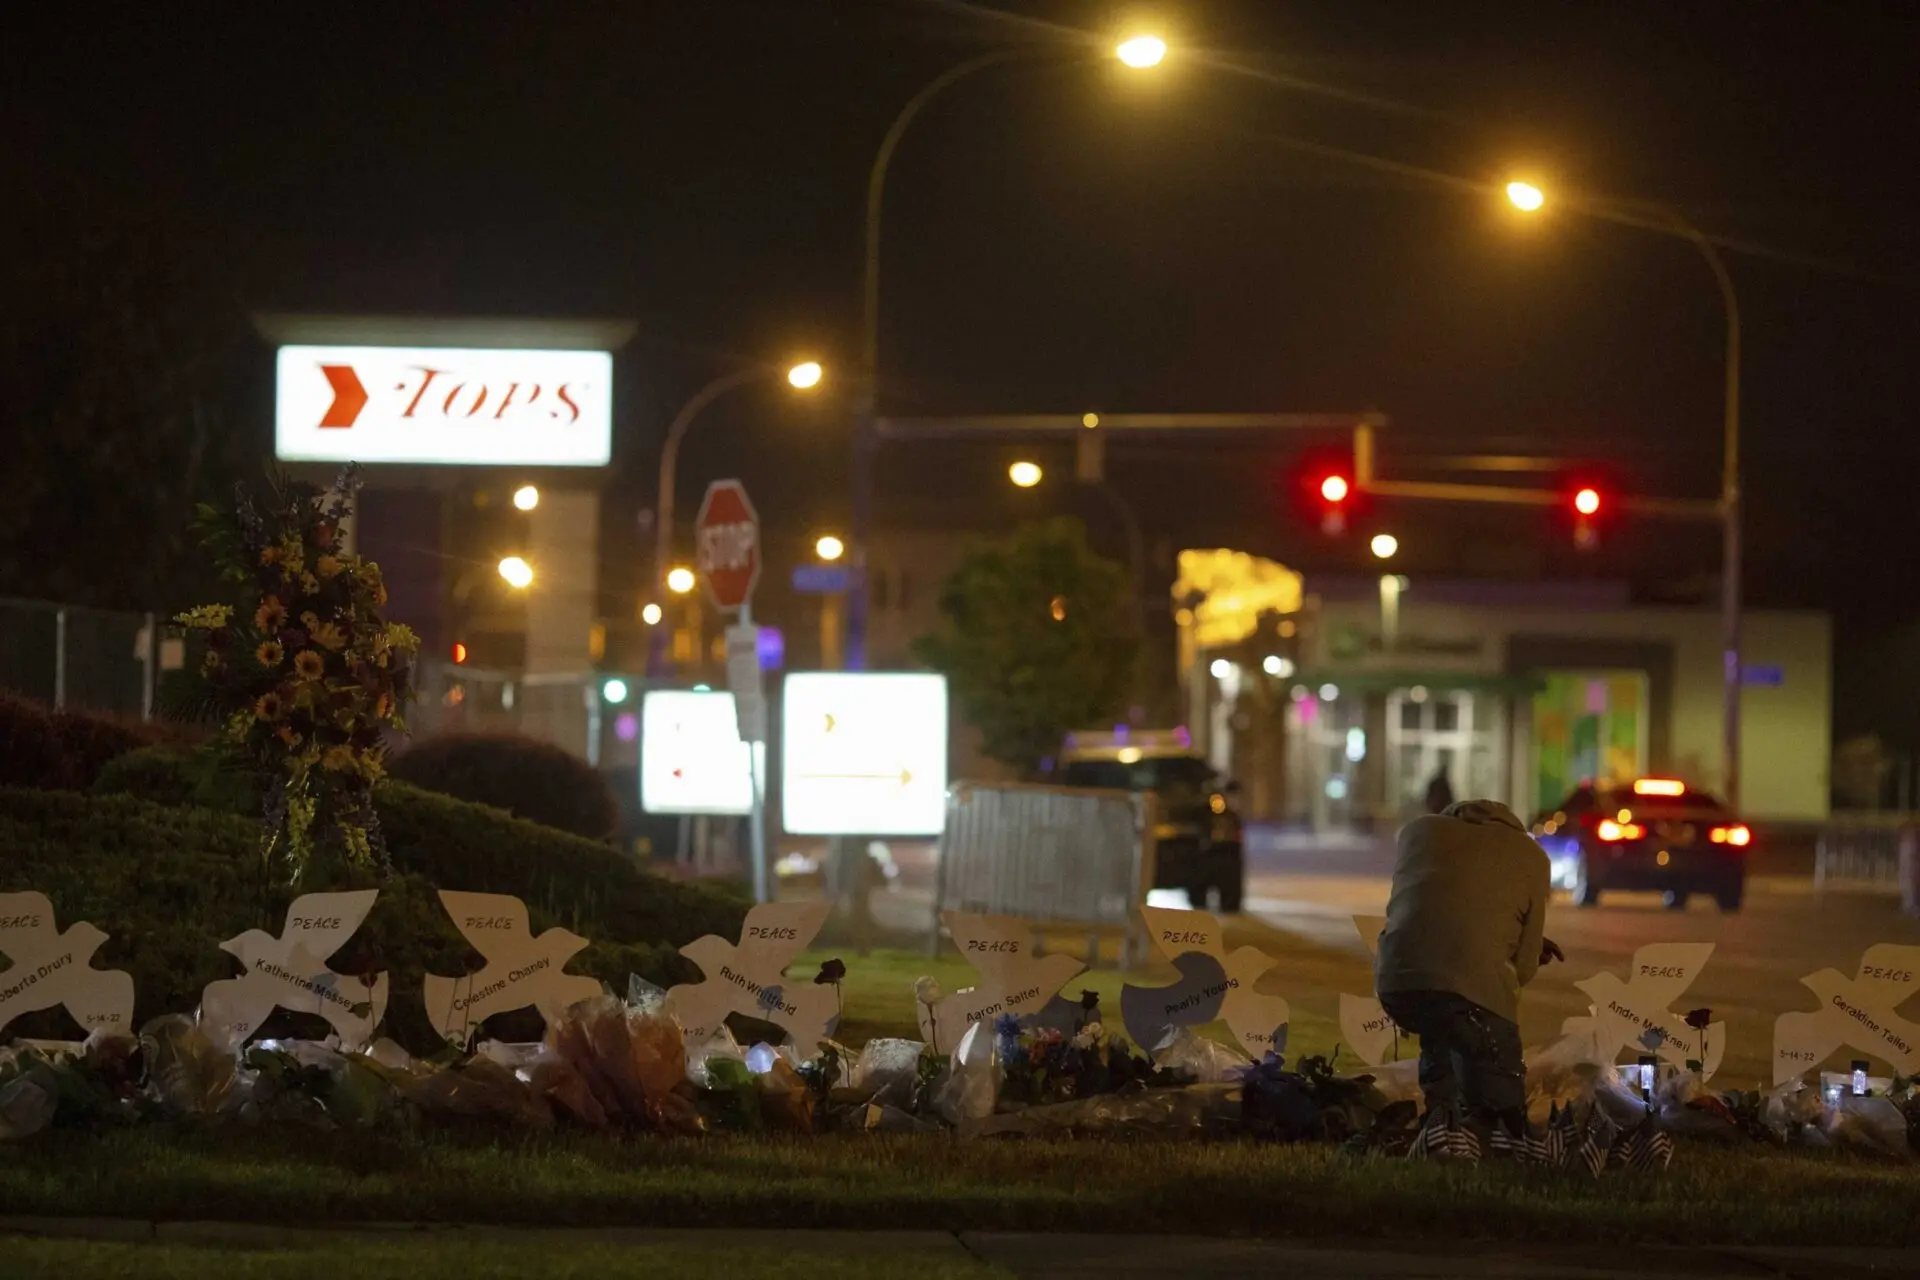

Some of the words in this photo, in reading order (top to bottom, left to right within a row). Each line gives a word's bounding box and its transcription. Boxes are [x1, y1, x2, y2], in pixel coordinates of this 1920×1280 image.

[701, 520, 757, 572] STOP
[0, 914, 41, 928] EACE
[292, 917, 342, 930] PEACE
[465, 917, 514, 930] PEACE
[749, 926, 798, 940] PEACE
[1163, 930, 1209, 945] PEACE
[967, 940, 1020, 953] PEACE
[37, 952, 73, 979] Drury
[255, 958, 313, 990] Katherine
[1640, 965, 1685, 979] PEACE
[1863, 965, 1914, 983] PEACE
[453, 979, 506, 1011] Celestine
[508, 956, 551, 983] Chaney
[719, 965, 747, 988] Ruth
[747, 981, 798, 1017] Whitfield
[966, 1002, 1002, 1025] Aaron
[1005, 986, 1042, 1007] Salter
[1165, 992, 1201, 1016] Pearly
[1202, 977, 1240, 1000] Young
[1608, 1000, 1641, 1024] Andre
[1832, 994, 1880, 1033] Geraldine
[1882, 1027, 1914, 1056] Talley
[1780, 1049, 1815, 1061] 5-14-22
